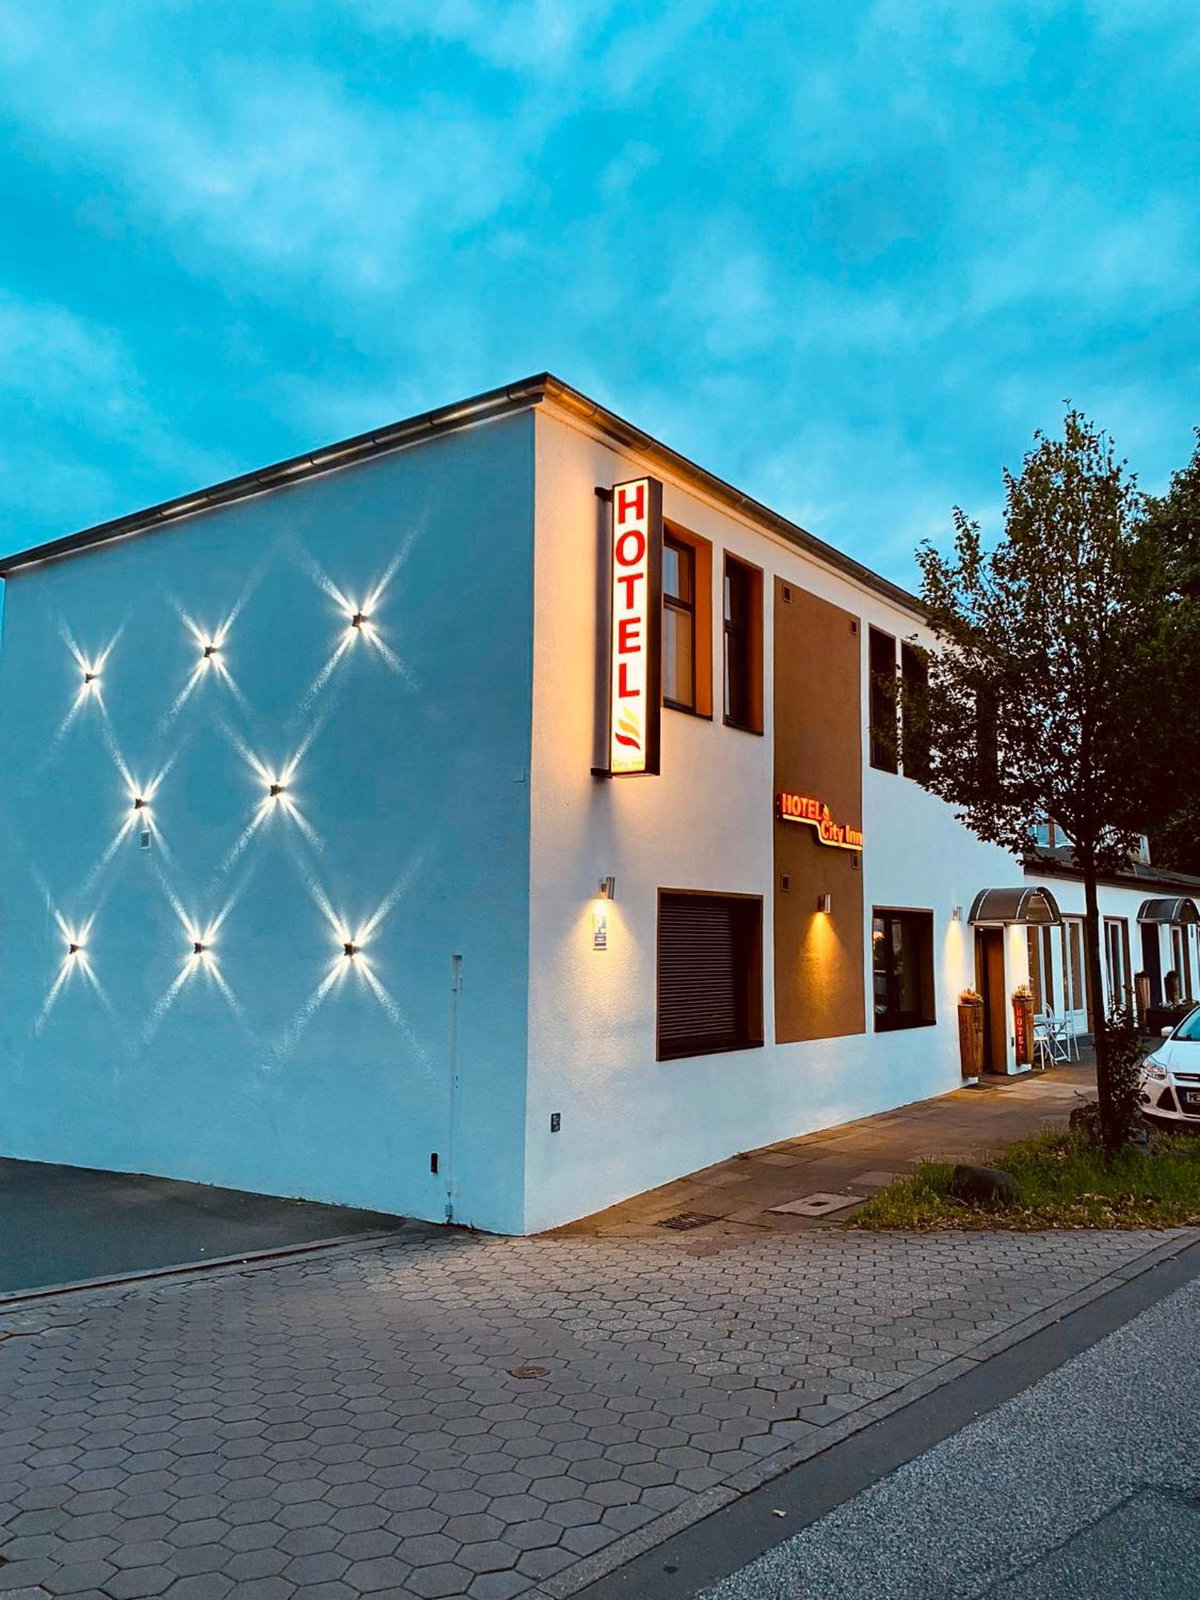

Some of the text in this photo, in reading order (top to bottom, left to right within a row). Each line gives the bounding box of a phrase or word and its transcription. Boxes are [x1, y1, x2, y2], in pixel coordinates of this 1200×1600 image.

[615, 485, 646, 698] HOTEL
[782, 793, 823, 820] HOTEL
[820, 819, 863, 846] City Inn
[1016, 1007, 1024, 1053] HOTEL
